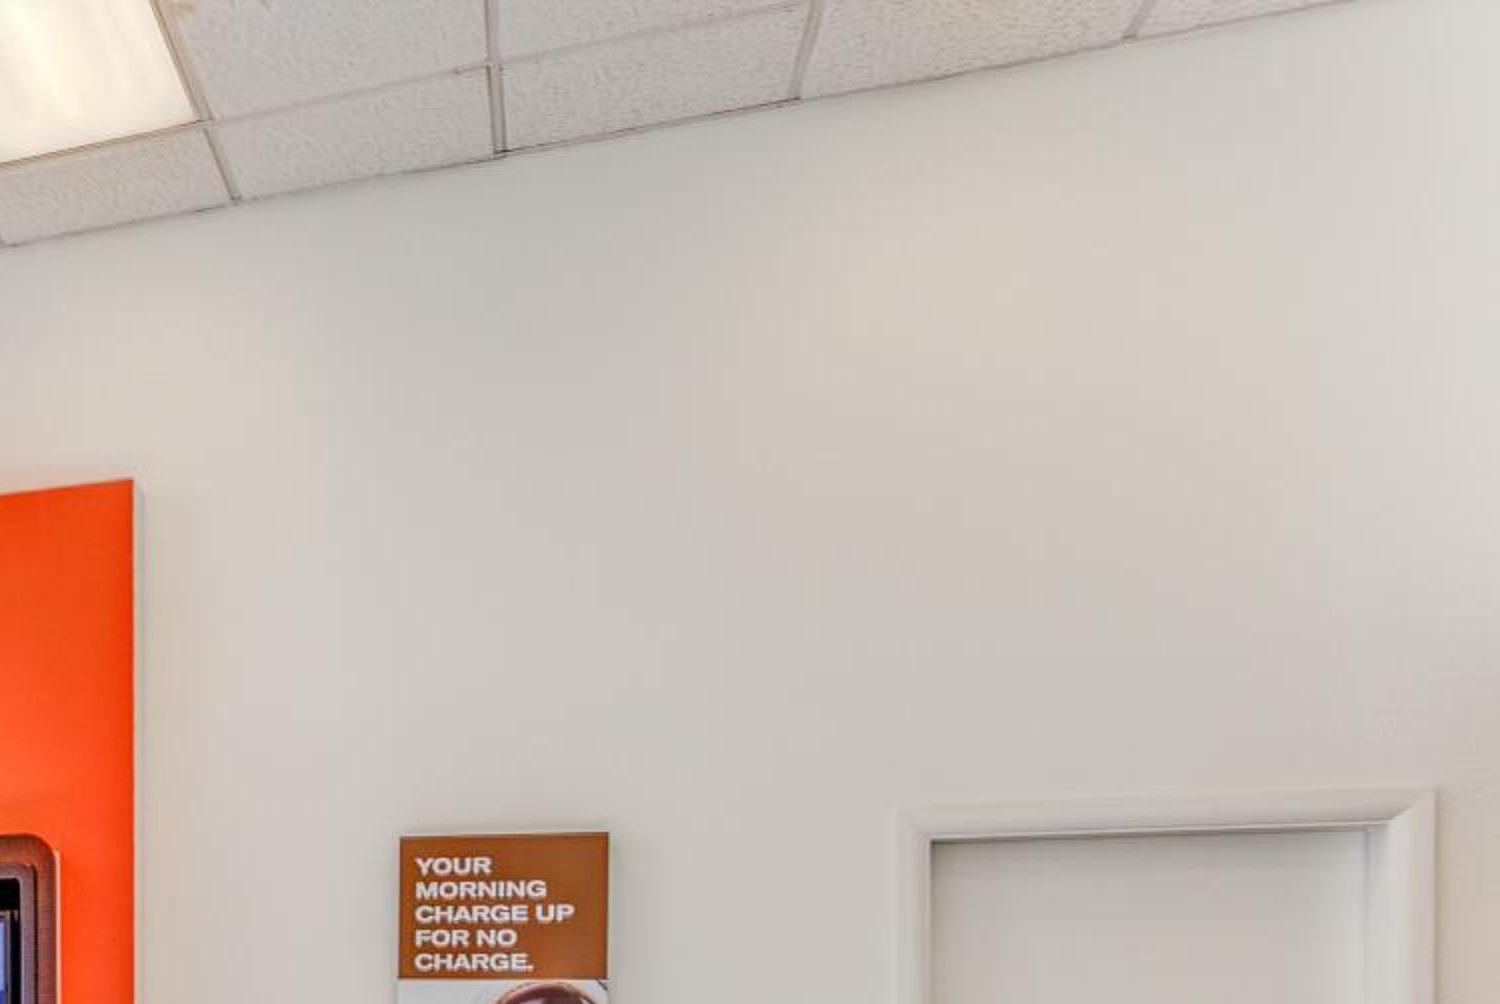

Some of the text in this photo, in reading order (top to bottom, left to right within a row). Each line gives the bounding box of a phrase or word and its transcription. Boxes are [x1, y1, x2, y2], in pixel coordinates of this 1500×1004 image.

[415, 857, 492, 876] YOUR
[415, 880, 547, 899] MORNING
[415, 904, 575, 924] CHARGE UP
[414, 929, 517, 948] FOR NO
[414, 953, 534, 971] CHARGE.
